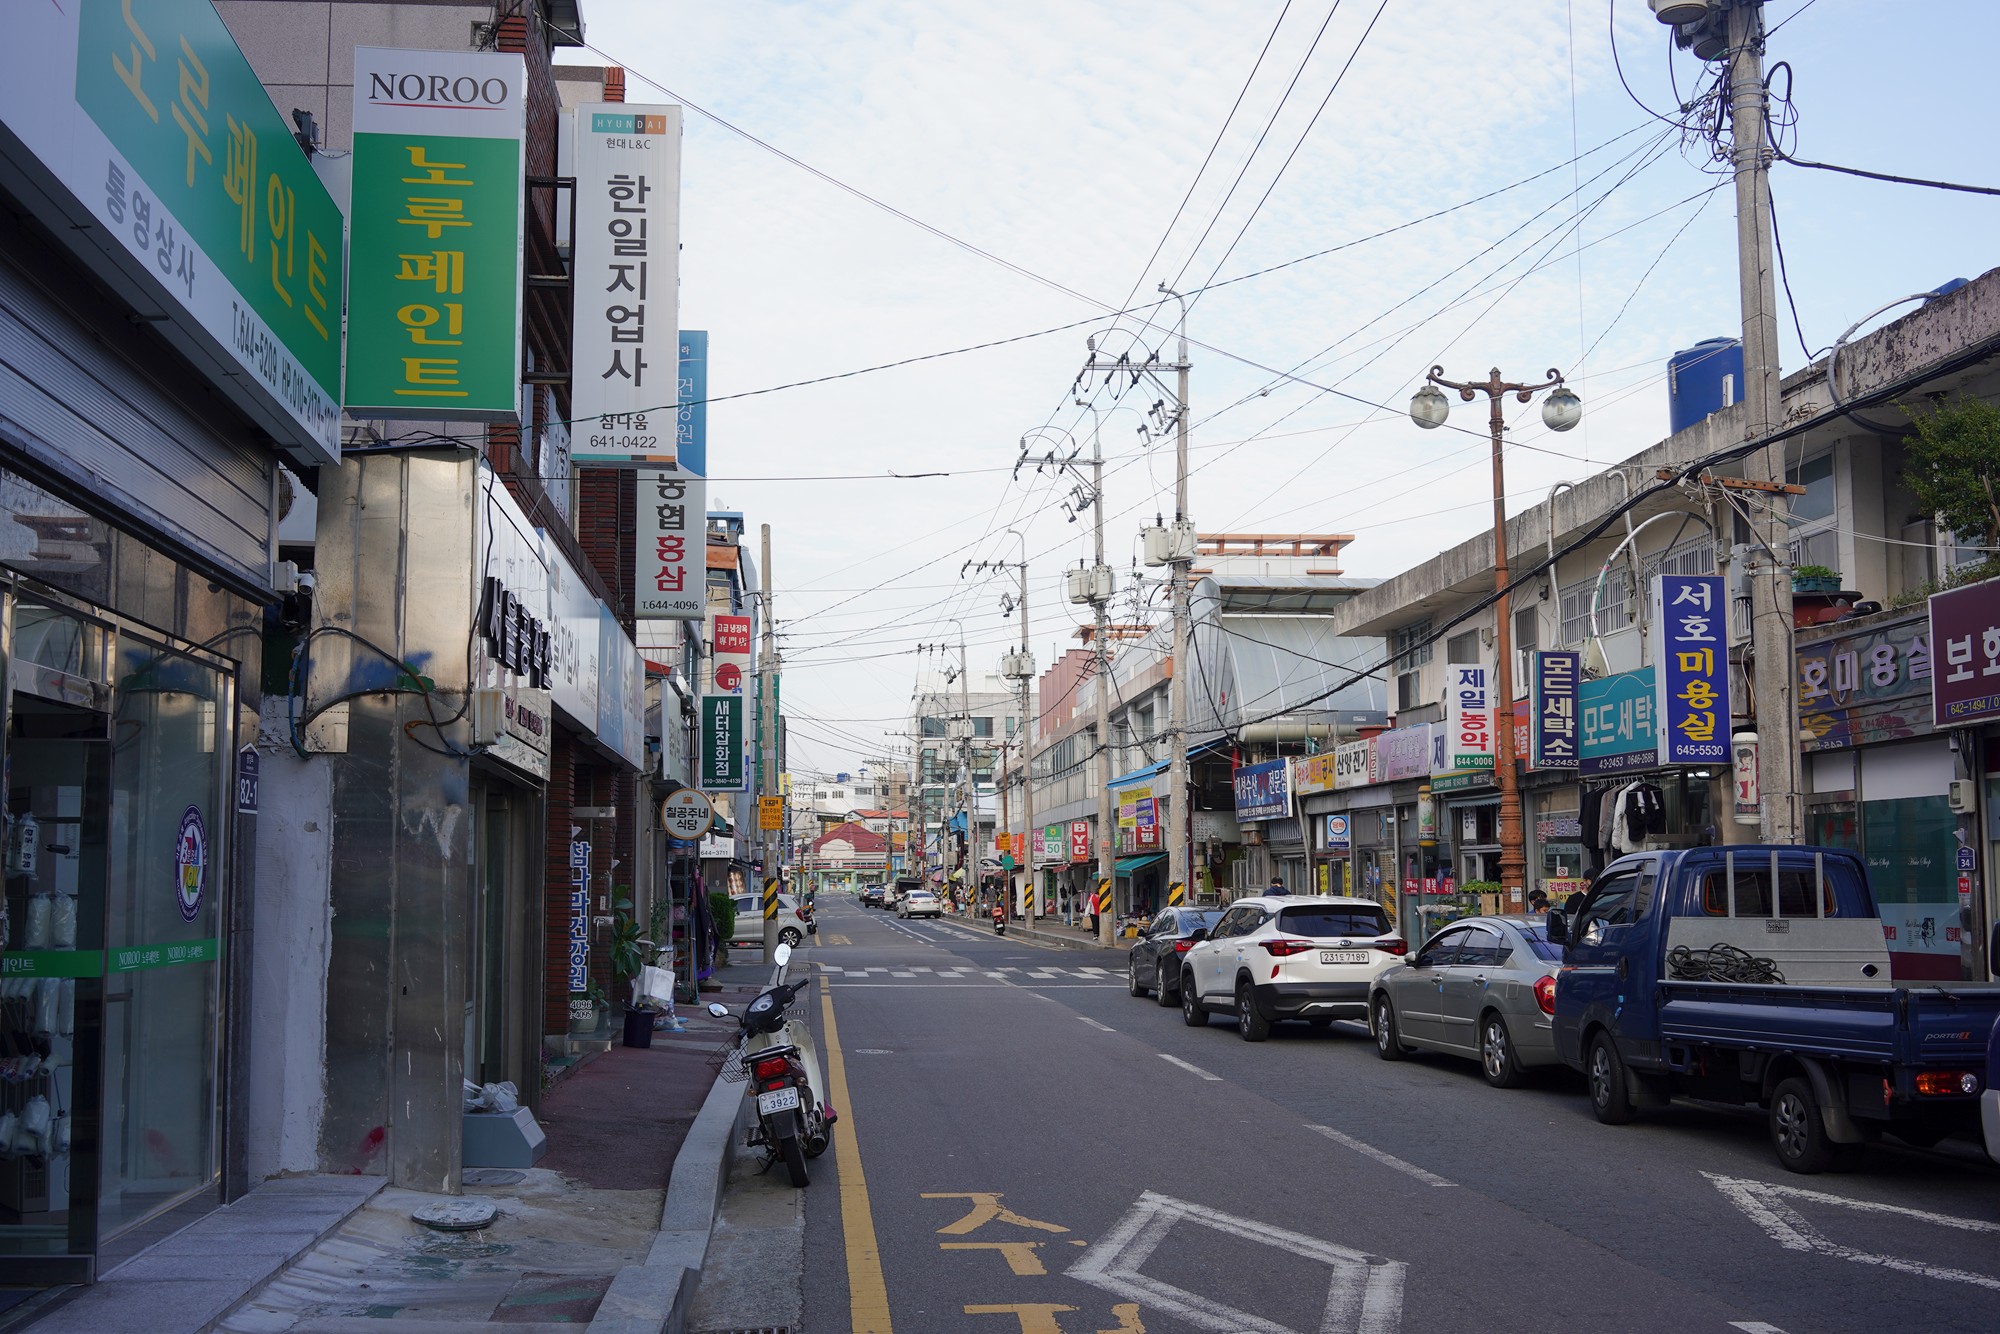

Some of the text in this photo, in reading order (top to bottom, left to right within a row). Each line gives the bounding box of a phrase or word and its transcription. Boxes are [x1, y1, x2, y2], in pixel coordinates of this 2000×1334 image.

[369, 72, 508, 105] NOROO
[596, 117, 663, 130] HYUNDAI
[605, 138, 652, 150] 현대 L&C
[112, 0, 329, 341] 노루페인트
[104, 157, 196, 300] 통영상사
[393, 146, 474, 397] 노루페인트
[602, 173, 652, 388] 한일지업사
[232, 300, 278, 388] T.644-5209
[677, 376, 694, 445] 건강원
[599, 413, 649, 431] 참다움
[590, 435, 657, 449] 641-0422
[642, 600, 699, 612] T.644-4096
[717, 623, 729, 633] 고급
[1672, 582, 1719, 742] 서호미용실
[1459, 668, 1489, 752] 제일농약
[1544, 657, 1574, 757] 모드세탁소
[1950, 699, 1986, 715] 642-1494
[1584, 695, 1657, 747] 모드세탁
[715, 700, 730, 776] 새터잡화점
[1676, 744, 1724, 757] 645-5530
[1337, 748, 1369, 776] 산양전기
[1456, 757, 1493, 766] 644-0006
[240, 778, 258, 805] 82-1
[666, 807, 709, 820] 칠공주네
[676, 818, 699, 831] 식당
[1332, 821, 1345, 829] 담배
[1073, 823, 1086, 855] BYC
[1047, 843, 1060, 854] 50
[1960, 859, 1971, 868] 34
[1549, 881, 1577, 892] 김밥한줄
[569, 841, 592, 993] 참나라건강원
[118, 950, 140, 967] NOROO
[167, 945, 187, 961] NOROO
[770, 1096, 795, 1109] 3922
